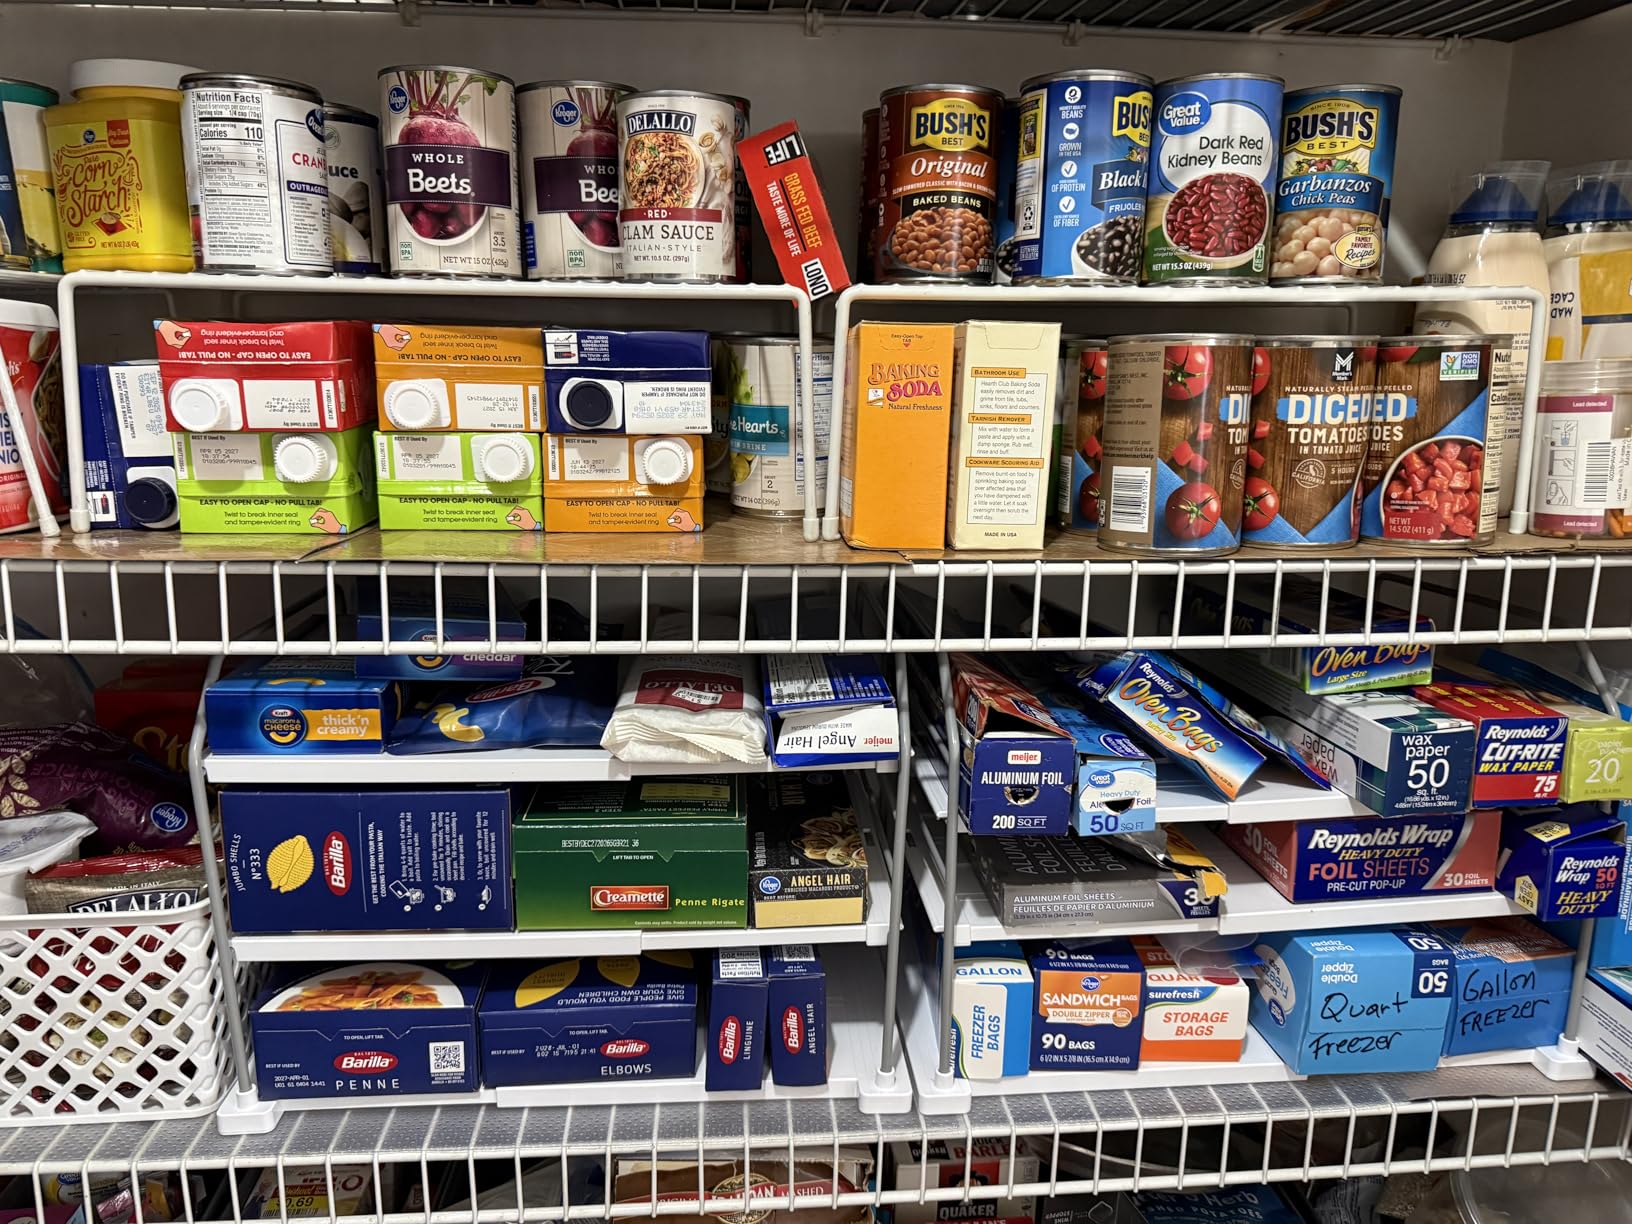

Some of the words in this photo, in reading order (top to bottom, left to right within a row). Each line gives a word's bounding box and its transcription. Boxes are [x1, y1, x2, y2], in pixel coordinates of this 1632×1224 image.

[196, 92, 232, 103] Nutrition
[234, 93, 261, 104] Facts
[554, 107, 578, 121] Kroger
[1061, 109, 1083, 119] BEANS
[1163, 101, 1201, 119] Great
[628, 113, 692, 134] DELALLO
[915, 111, 987, 141] BUSH'S
[1169, 114, 1201, 128] Value
[1286, 110, 1374, 147] BUSH'S
[200, 128, 228, 138] Calories
[244, 127, 263, 139] 110
[765, 132, 801, 166] LIFE
[941, 137, 964, 147] BEST
[1199, 135, 1233, 151] Dark
[1239, 135, 1264, 149] Red
[1307, 140, 1349, 151] BEST
[411, 152, 464, 165] WHOLE
[1167, 153, 1217, 169] Kidney
[1221, 152, 1263, 167] Beans
[73, 158, 120, 187] Corn
[584, 165, 618, 175] WHO
[910, 156, 989, 179] Original
[406, 167, 471, 196] Beets
[1051, 184, 1059, 193] OF
[1060, 183, 1086, 192] PROTEIN
[1099, 170, 1141, 191] Black
[1279, 174, 1372, 197] Garbanzos
[579, 179, 619, 203] Bee
[784, 172, 808, 206] GRASS
[65, 175, 131, 228] Starch
[912, 196, 947, 206] BAKED
[951, 196, 982, 208] BEANS
[1291, 193, 1325, 206] Chick
[1328, 192, 1357, 205] Peas
[647, 210, 668, 219] RED
[796, 204, 810, 226] FED
[622, 225, 655, 240] CLAM
[660, 225, 714, 241] SAUCE
[802, 223, 823, 249] BEEF
[443, 255, 457, 264] NET
[458, 256, 472, 265] WT
[473, 256, 481, 265] 15
[481, 257, 492, 266] OZ
[492, 257, 509, 267] (425g)
[804, 262, 829, 297] LONO
[178, 351, 198, 359] TAB!
[199, 351, 217, 359] PULL
[217, 351, 232, 359] NO
[290, 352, 311, 360] EASY
[867, 361, 940, 385] BAKING
[886, 380, 943, 401] SODA
[888, 402, 911, 410] Natural
[912, 402, 943, 411] Freshness
[1287, 393, 1372, 425] DICED
[737, 416, 779, 434] Hearts
[1287, 426, 1368, 444] TOMATOES
[1138, 661, 1176, 694] Reynolds
[321, 713, 369, 726] thick'n
[1118, 676, 1171, 725] Oven
[1168, 705, 1224, 754] Bags
[316, 725, 368, 737] creamy
[1484, 724, 1550, 740] Reynolds
[784, 735, 813, 748] Hair
[818, 734, 857, 750] Angel
[864, 736, 893, 746] meijer
[1402, 736, 1433, 747] wax
[1010, 752, 1039, 763] meijer
[1404, 742, 1450, 761] paper
[1481, 742, 1564, 761] CUT-RITE
[1406, 759, 1449, 790] 50
[1478, 762, 1509, 774] WAX
[1511, 761, 1554, 773] PAPER
[1585, 756, 1621, 785] 20
[981, 771, 1039, 785] ALUMINUM
[1041, 771, 1065, 785] FOIL
[1533, 774, 1557, 794] 75
[992, 814, 1016, 829] 200
[1017, 818, 1032, 828] SQ
[1033, 817, 1047, 826] FT
[1308, 828, 1399, 853] Reynolds
[1400, 824, 1453, 849] Wrap
[230, 833, 241, 864] SHELLS
[1338, 849, 1382, 861] HEAVY
[1383, 847, 1425, 859] DUTY
[330, 838, 346, 888] Barilla
[1308, 862, 1358, 881] FOIL
[1362, 857, 1430, 879] SHEETS
[1560, 855, 1620, 872] Reynolds
[232, 862, 247, 892] JUMBO
[790, 874, 824, 887] ANGEL
[825, 873, 851, 885] HAIR
[1555, 870, 1591, 885] Wrap
[1595, 867, 1618, 883] 50
[379, 874, 387, 897] COOKING
[1327, 880, 1369, 893] PRE-CUT
[1369, 879, 1406, 890] POP-UP
[594, 889, 665, 905] Creamette
[675, 898, 707, 907] Penne
[711, 897, 745, 909] Rigate
[1013, 892, 1062, 904] ALUMINUM
[1062, 893, 1082, 902] FOIL
[1083, 892, 1115, 902] SHEETS
[1556, 890, 1613, 905] HEAVY
[1013, 904, 1052, 914] FEUILLES
[1053, 904, 1065, 912] DE
[1066, 903, 1097, 912] PAPIER
[1097, 900, 1155, 911] D'ALUMINIUM
[1557, 903, 1600, 915] DUTY
[956, 966, 1023, 977] GALLON
[1321, 962, 1357, 974] Zipper
[1321, 973, 1359, 984] Double
[1418, 971, 1449, 995] 50
[1042, 992, 1121, 1007] SANDWICH
[1148, 989, 1201, 1000] surefresh
[1052, 1010, 1082, 1018] DOUBLE
[1084, 1010, 1111, 1018] ZIPPER
[1320, 991, 1410, 1023] Quart
[1162, 1011, 1230, 1024] STORAGE
[787, 1010, 799, 1049] Barilla
[970, 1005, 987, 1060] FREEZER
[986, 1015, 1001, 1051] BAGS
[1174, 1025, 1214, 1037] BAGS
[722, 1020, 738, 1060] Barilla
[743, 1020, 754, 1060] LINGUINE
[1041, 1033, 1067, 1049] 90
[1068, 1040, 1096, 1050] BAGS
[1307, 1029, 1403, 1060] Freezer
[605, 1043, 644, 1054] Barilla
[341, 1056, 392, 1069] Barilla
[600, 1063, 652, 1076] ELBOWS
[335, 1078, 401, 1091] PENNE
[939, 1203, 995, 1220] QUAKER
